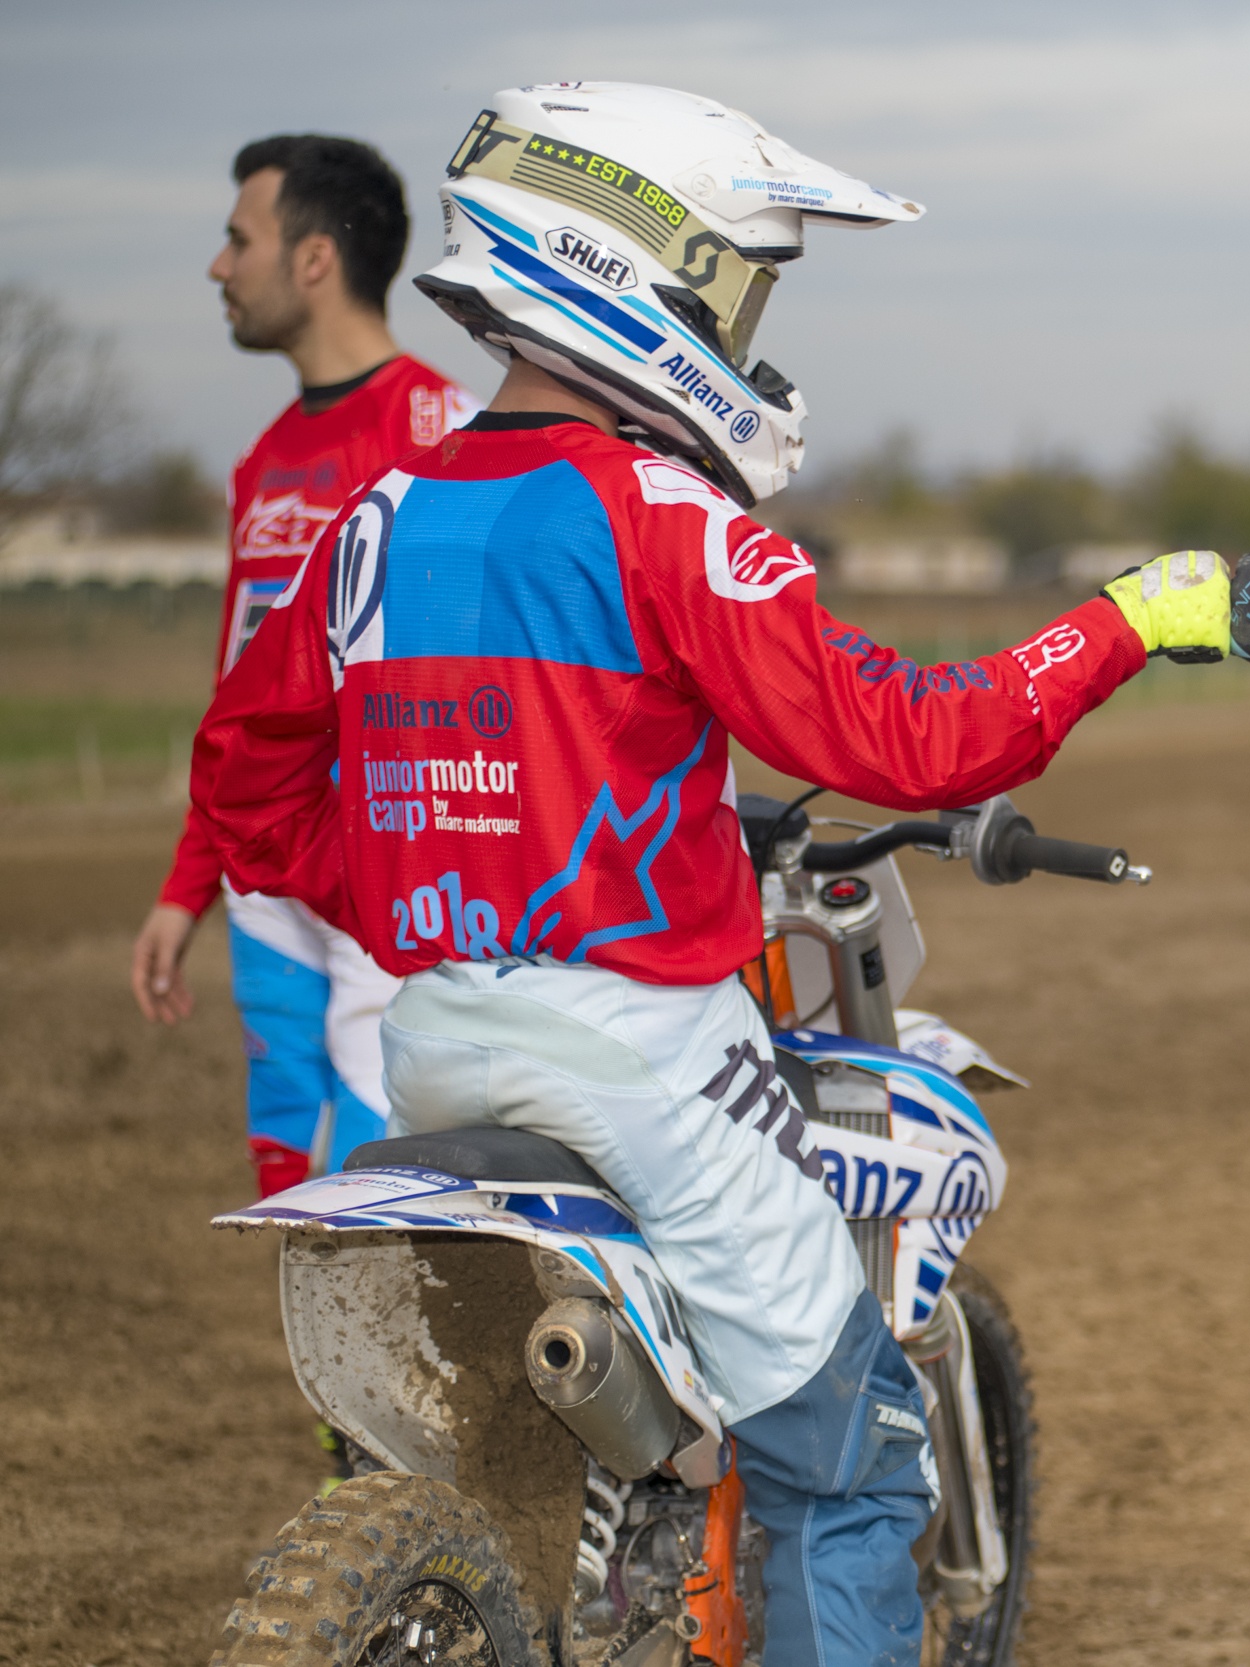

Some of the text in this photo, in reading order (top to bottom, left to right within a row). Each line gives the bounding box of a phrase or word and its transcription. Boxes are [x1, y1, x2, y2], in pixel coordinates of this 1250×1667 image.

[585, 155, 686, 227] EST 1958
[731, 175, 833, 199] juniormotorcamp
[768, 192, 776, 202] by
[778, 194, 795, 203] marc
[554, 232, 630, 286] SHOEI
[658, 352, 735, 422] Allianz
[363, 693, 459, 729] Allianz
[432, 795, 449, 816] by
[435, 814, 520, 837] marc márquez
[392, 871, 500, 961] 2018
[699, 1038, 828, 1188] THO
[419, 1554, 487, 1592] MAXXIS
